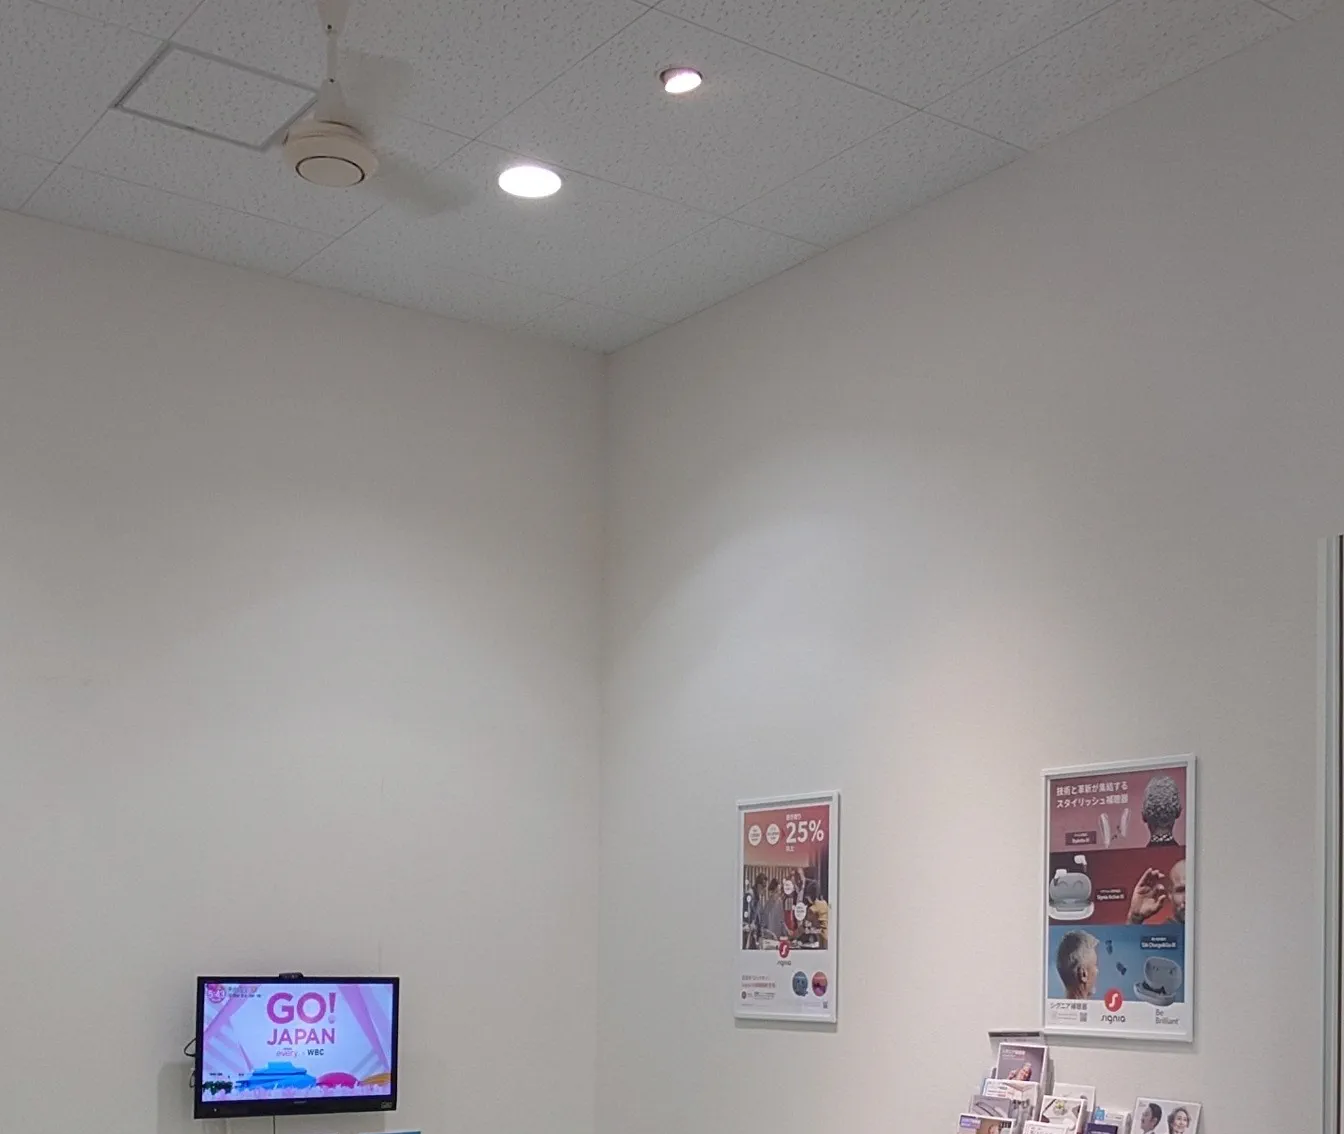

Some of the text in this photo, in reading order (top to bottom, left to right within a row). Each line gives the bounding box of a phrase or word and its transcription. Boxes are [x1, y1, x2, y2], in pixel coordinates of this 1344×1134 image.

[1056, 781, 1128, 796] 技術と革新が集結する
[1056, 794, 1129, 808] スタイリッシュ補聴器
[785, 820, 825, 844] 25%
[267, 992, 337, 1024] GO!
[1050, 1003, 1088, 1011] シグニア補聴器
[1100, 1014, 1126, 1024] signia
[267, 1028, 335, 1046] JAPAN
